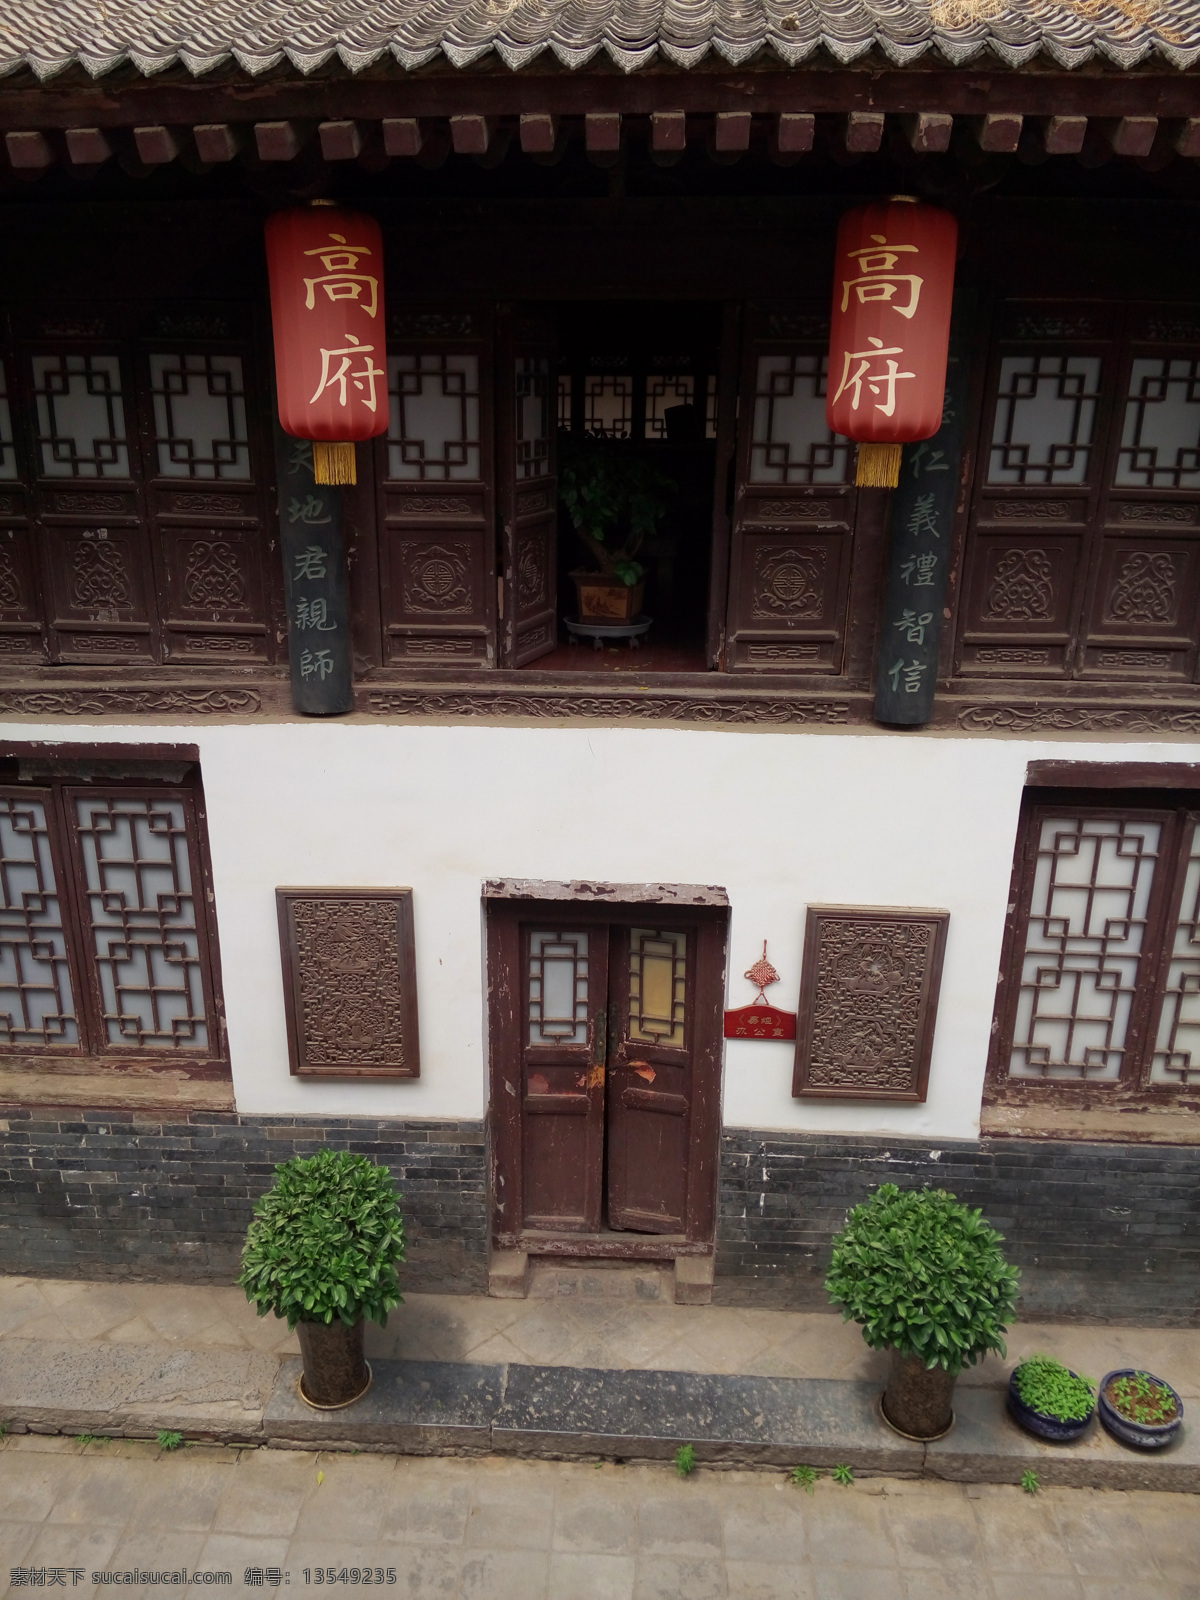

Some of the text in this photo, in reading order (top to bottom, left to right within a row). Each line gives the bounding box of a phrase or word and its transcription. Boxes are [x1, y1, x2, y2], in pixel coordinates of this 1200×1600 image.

[303, 232, 385, 413] 高府
[832, 234, 925, 417] 高府
[888, 384, 956, 694] 仁義禮智信
